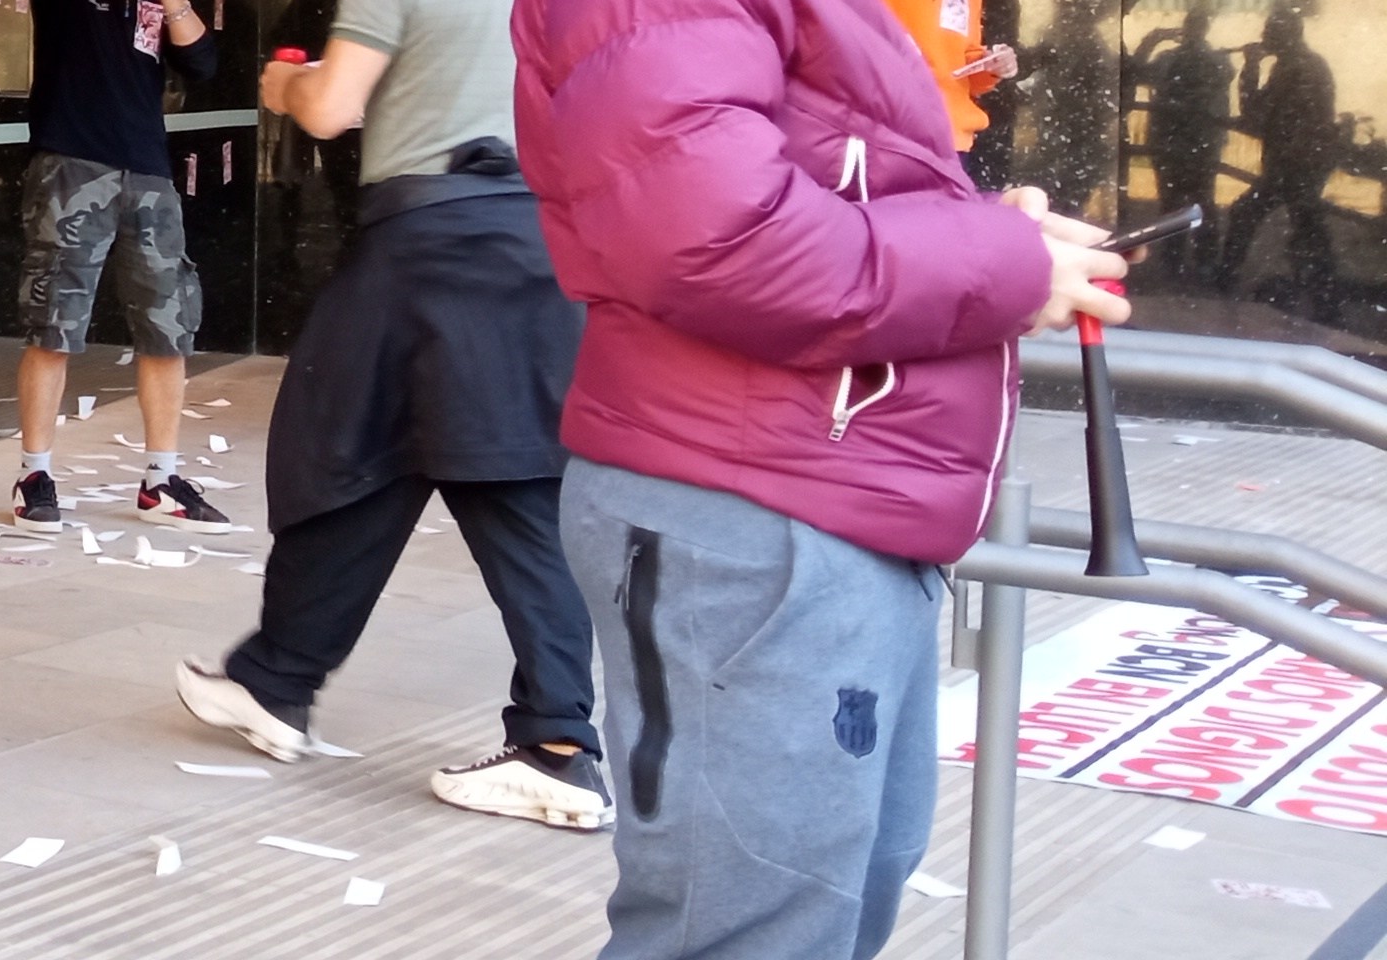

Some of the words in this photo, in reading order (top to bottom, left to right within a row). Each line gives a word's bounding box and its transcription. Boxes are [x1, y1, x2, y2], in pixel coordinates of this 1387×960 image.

[1095, 644, 1231, 685] BCN
[1053, 677, 1174, 708] EN
[1097, 705, 1319, 802] DIGNOS
